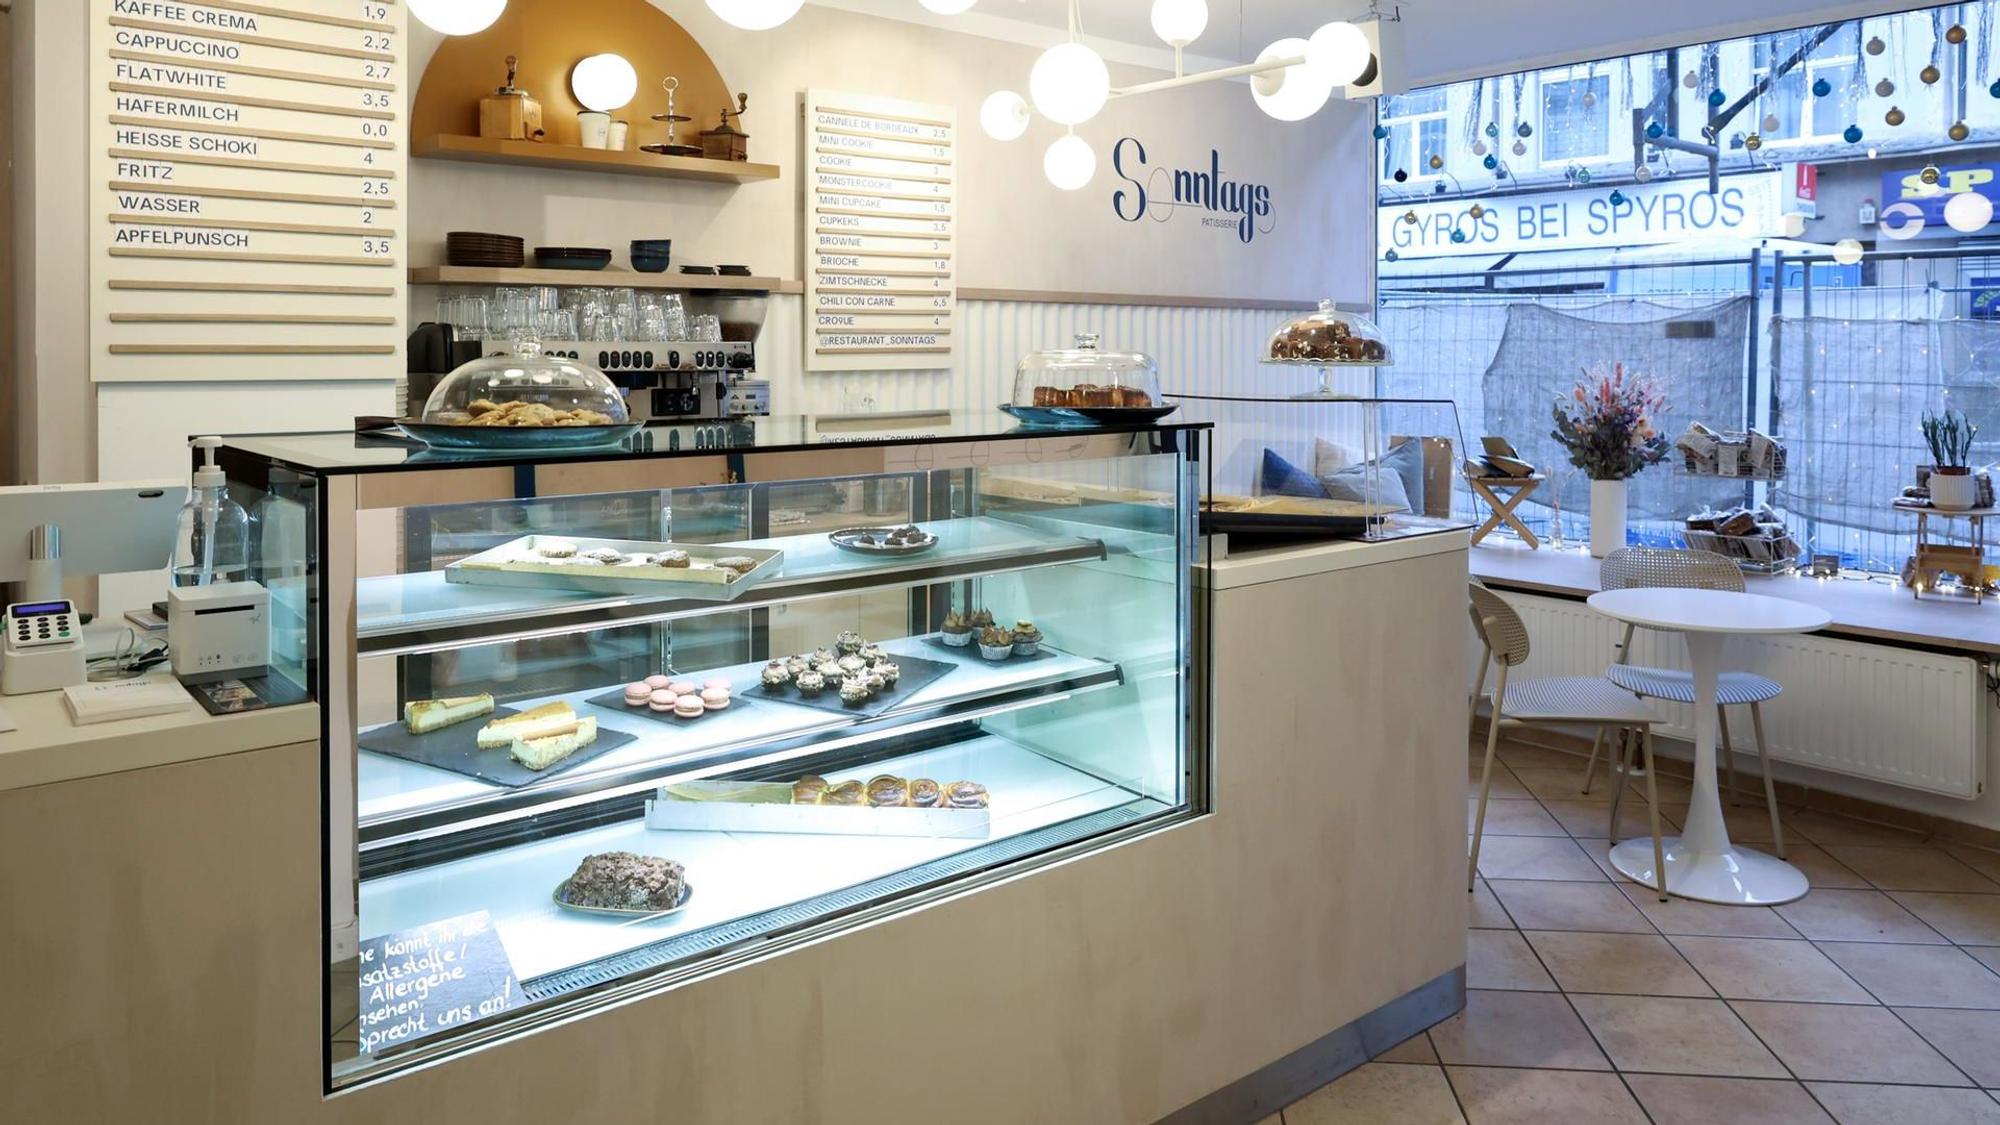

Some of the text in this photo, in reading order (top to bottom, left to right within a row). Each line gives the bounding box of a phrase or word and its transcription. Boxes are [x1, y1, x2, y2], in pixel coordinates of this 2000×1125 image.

[364, 5, 387, 21] 1,9
[114, 0, 390, 50] KAFFEE CREMA 2,2
[116, 31, 390, 79] CAPPUCCINO 2,7
[117, 64, 389, 108] FLATWHITE 3,5
[116, 97, 388, 138] HAFERMILCH 0,0
[861, 119, 872, 129] DE
[875, 121, 919, 135] BORDEAUX
[117, 130, 373, 165] HEISSE SCHOKI 4
[819, 135, 839, 146] MINI
[841, 137, 872, 149] COOKIE
[819, 155, 852, 167] COOKIE
[118, 163, 389, 196] FRITZ 2,5
[1113, 137, 1276, 243] Sonntags
[118, 195, 372, 224] WASSER 2
[819, 195, 839, 206] MINI
[842, 196, 881, 208] CUPCAKE
[820, 215, 859, 226] CUPKEKS
[1201, 217, 1238, 230] PATISSERIE
[1392, 208, 1499, 248] GYROS
[1517, 202, 1568, 240] BEI
[1588, 187, 1745, 236] SPYROS
[116, 228, 389, 254] APFELPUNSCH 3,5
[820, 236, 862, 247] BROWNIE
[821, 256, 859, 266] BRIOCHE
[820, 276, 888, 287] ZIMTSCHNECKE
[820, 296, 843, 306] CHILI
[845, 297, 865, 306] CON
[867, 297, 896, 307] CARNE
[933, 317, 939, 325] 4
[820, 335, 936, 347] @RESTAURANT_SONNTAGS
[369, 966, 467, 1005] Allergene
[437, 1003, 472, 1026] uns
[478, 975, 512, 1016] an!
